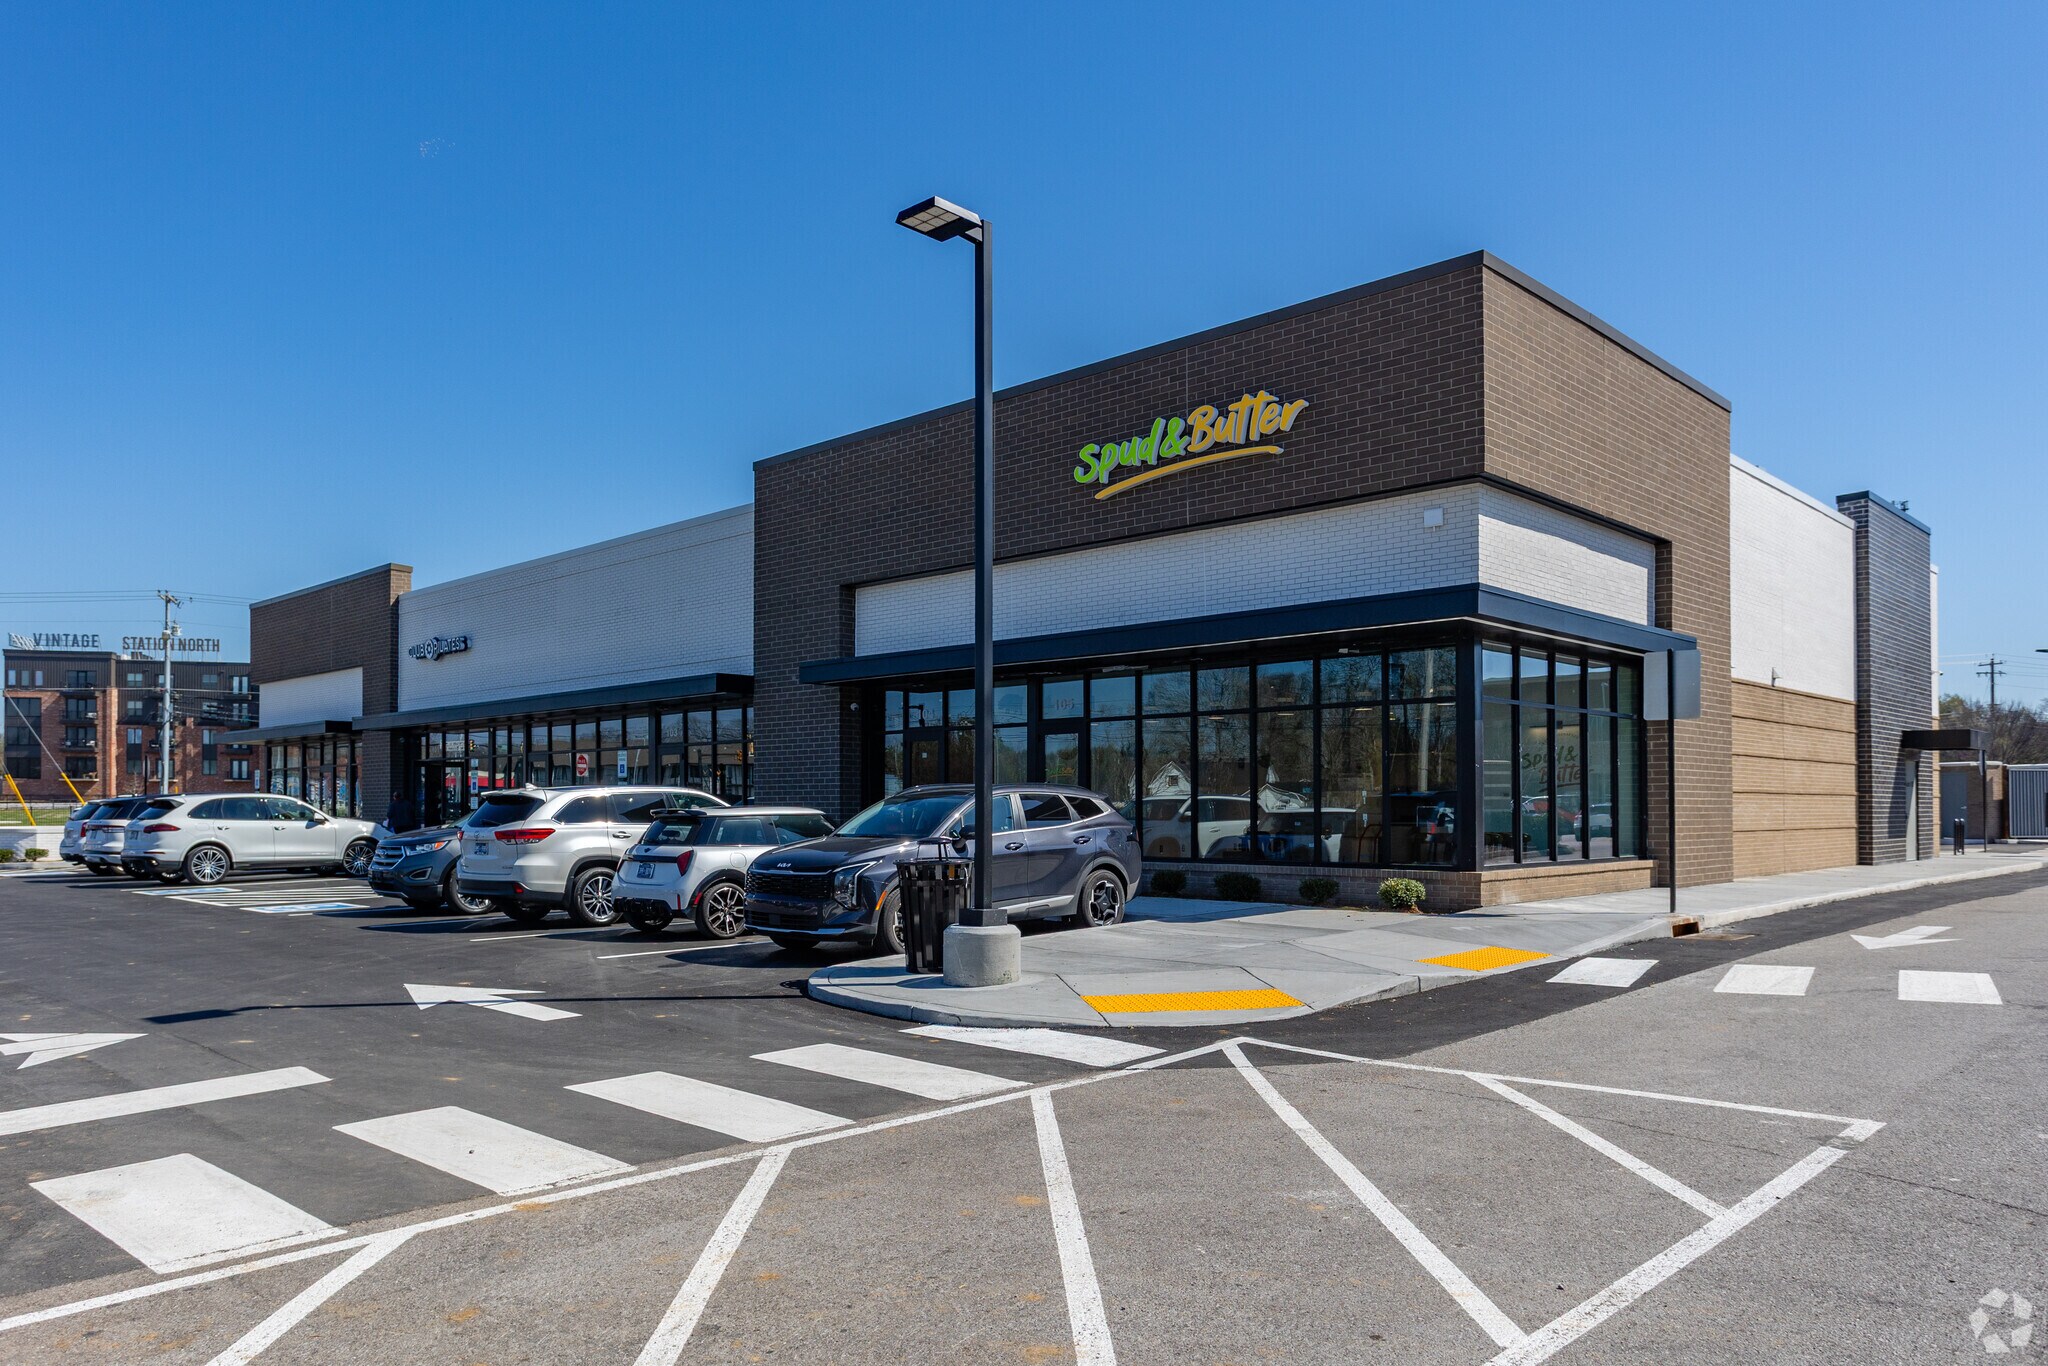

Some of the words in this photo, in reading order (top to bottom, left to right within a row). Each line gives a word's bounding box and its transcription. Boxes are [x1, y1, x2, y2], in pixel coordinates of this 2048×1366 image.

[33, 633, 99, 648] VINTAGE
[122, 636, 175, 651] STATION
[178, 638, 220, 653] NORTH
[408, 644, 425, 658] CLUB
[433, 637, 461, 655] PILATES
